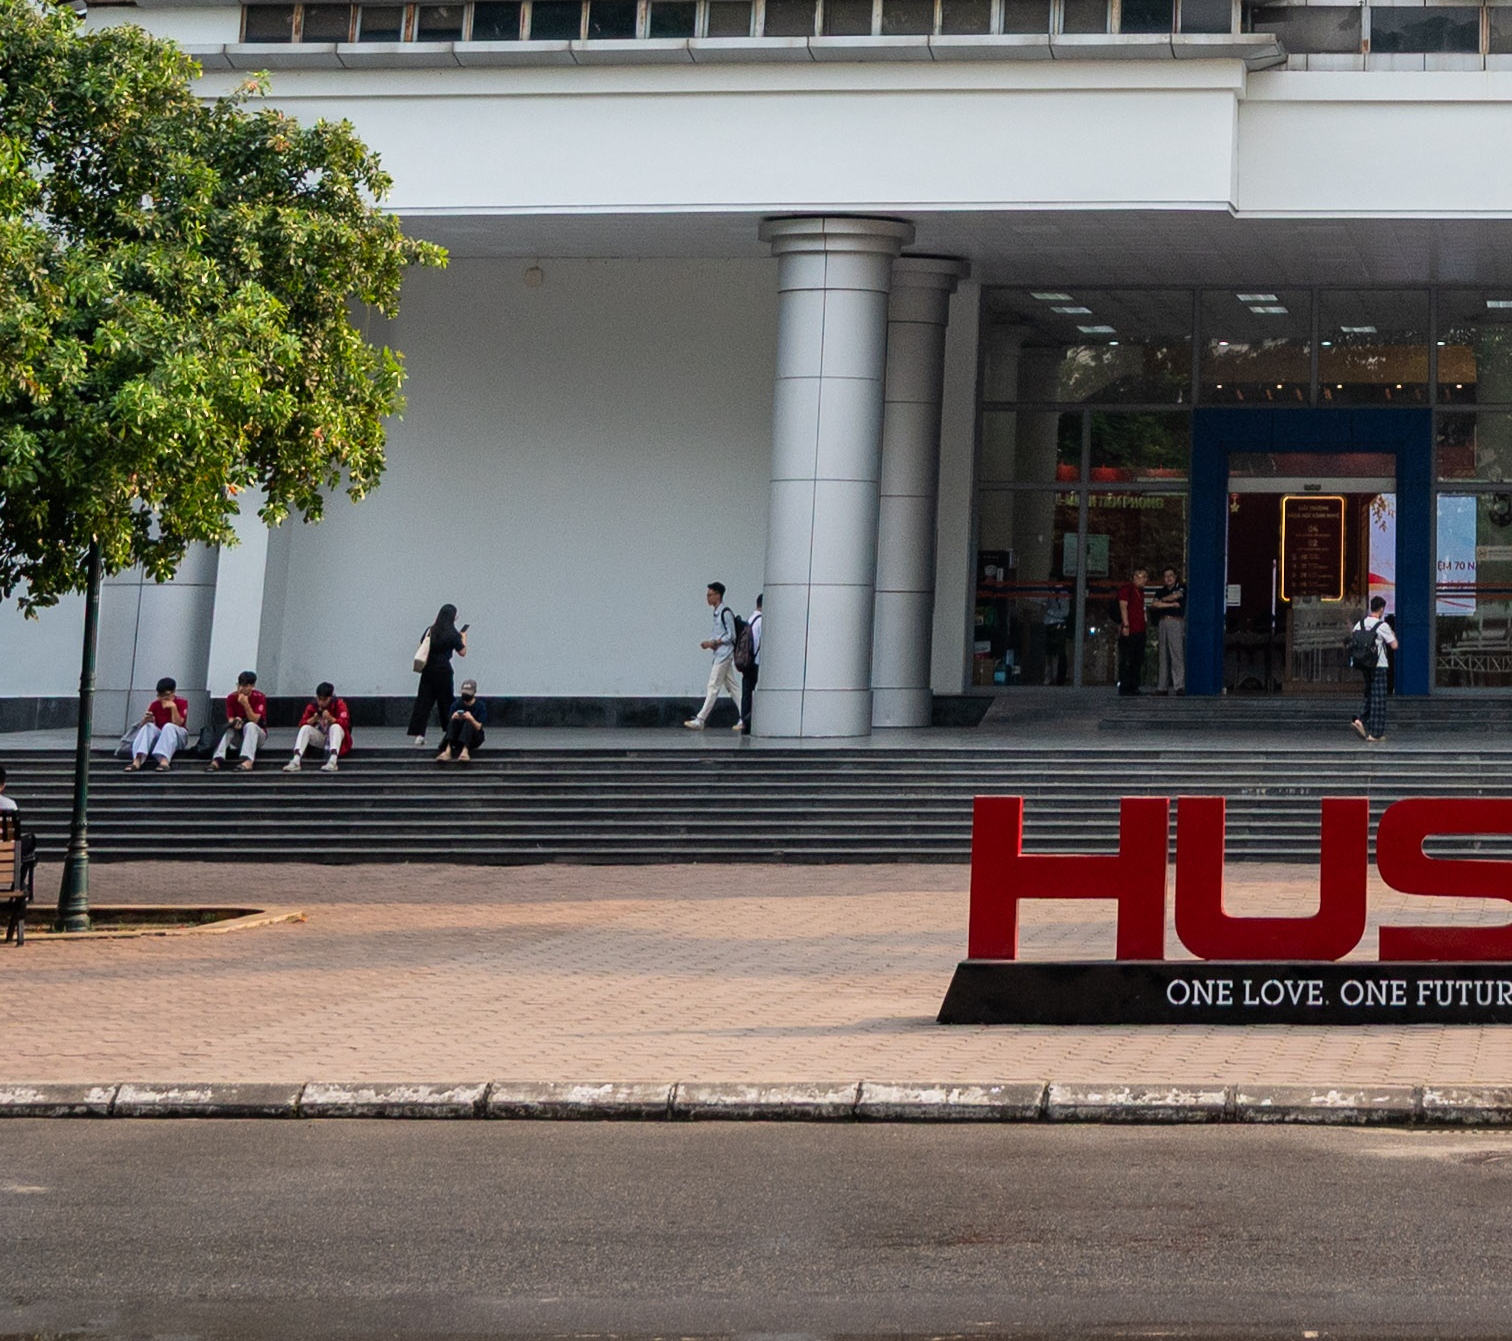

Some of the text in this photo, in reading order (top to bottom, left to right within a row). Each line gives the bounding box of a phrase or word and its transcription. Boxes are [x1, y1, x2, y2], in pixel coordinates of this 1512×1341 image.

[1166, 978, 1234, 1007] ONE
[1242, 978, 1330, 1007] LOVE.
[1339, 978, 1407, 1007] ONE
